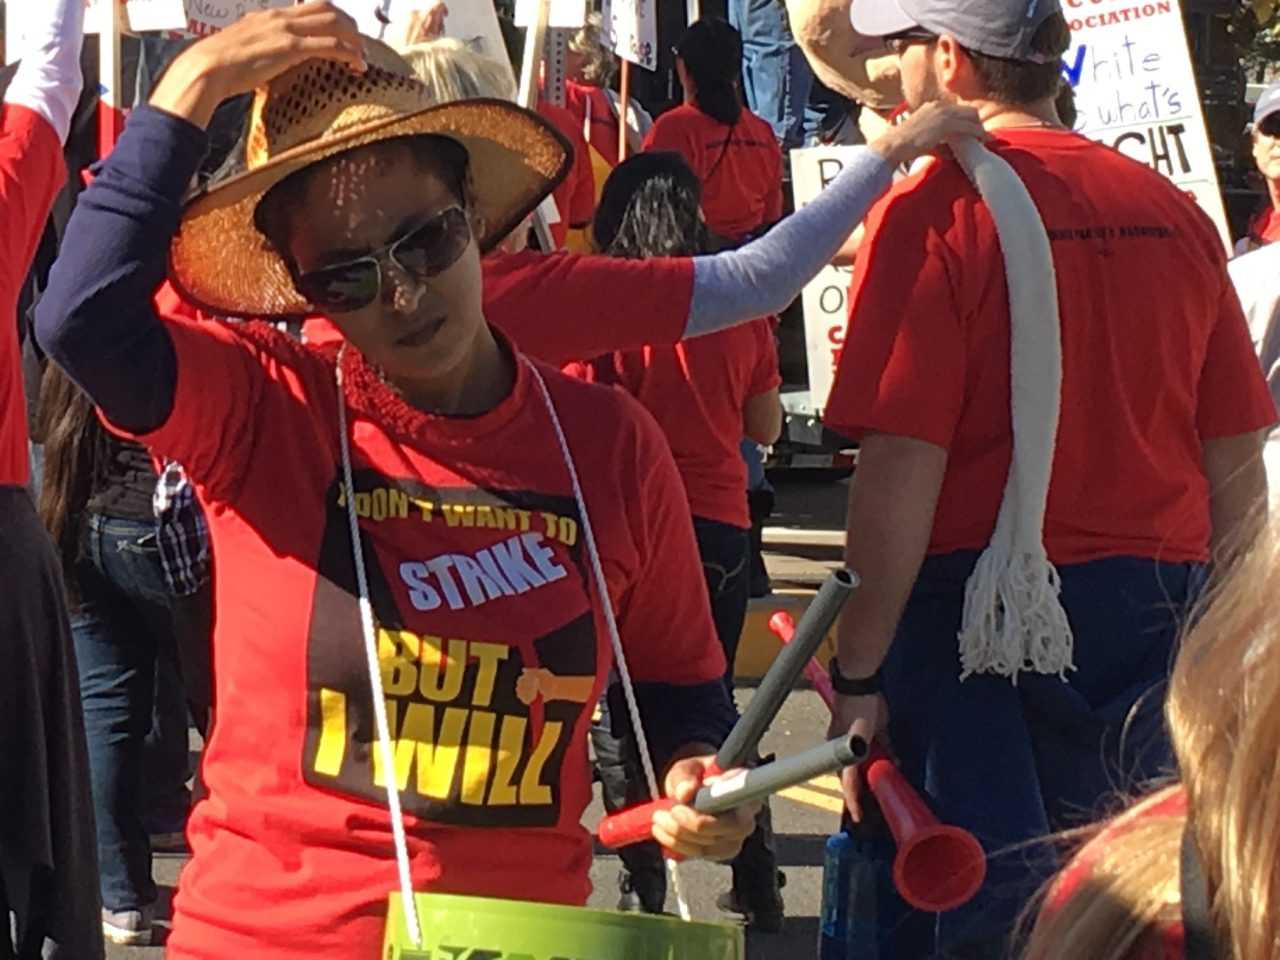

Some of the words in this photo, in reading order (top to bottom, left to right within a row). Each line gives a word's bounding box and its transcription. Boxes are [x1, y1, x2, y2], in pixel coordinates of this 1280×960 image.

[441, 504, 532, 532] WANT
[541, 511, 578, 546] TO
[399, 532, 568, 611] STRIKE
[377, 628, 509, 707] BUT
[313, 687, 346, 777] I
[372, 699, 563, 806] WILL
